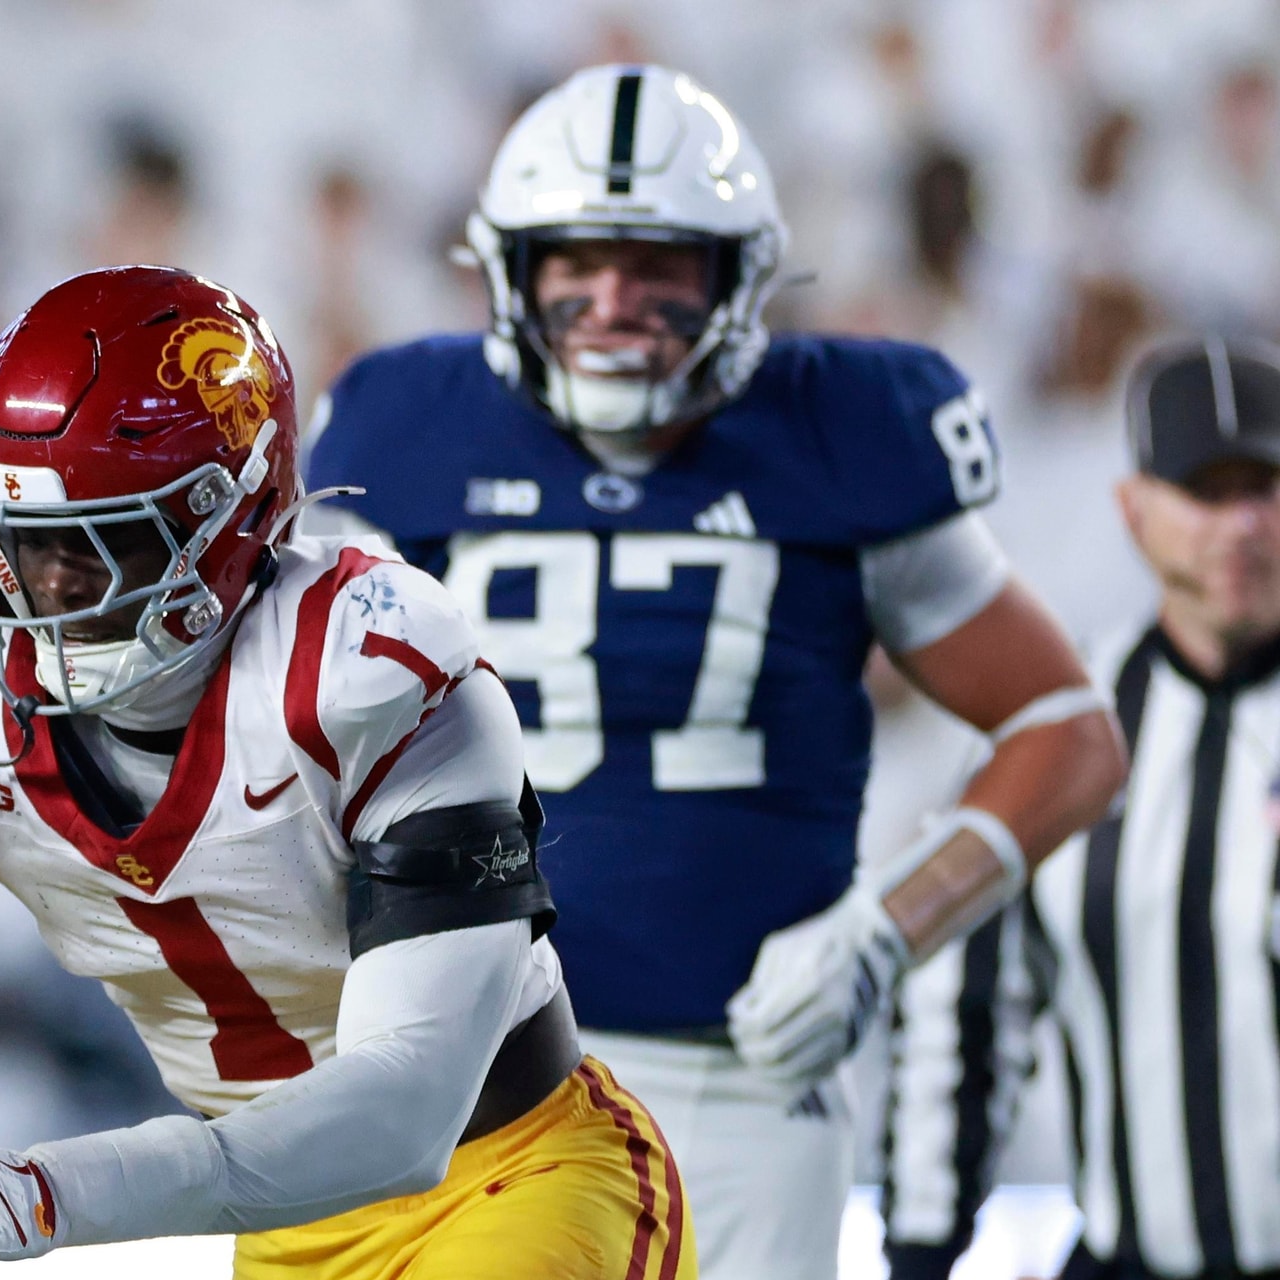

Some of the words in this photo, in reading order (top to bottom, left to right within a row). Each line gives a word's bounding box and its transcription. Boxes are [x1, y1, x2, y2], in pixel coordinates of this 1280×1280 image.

[5, 473, 21, 500] SC
[931, 397, 1000, 506] 8
[443, 530, 781, 792] 87
[113, 896, 315, 1083] 1
